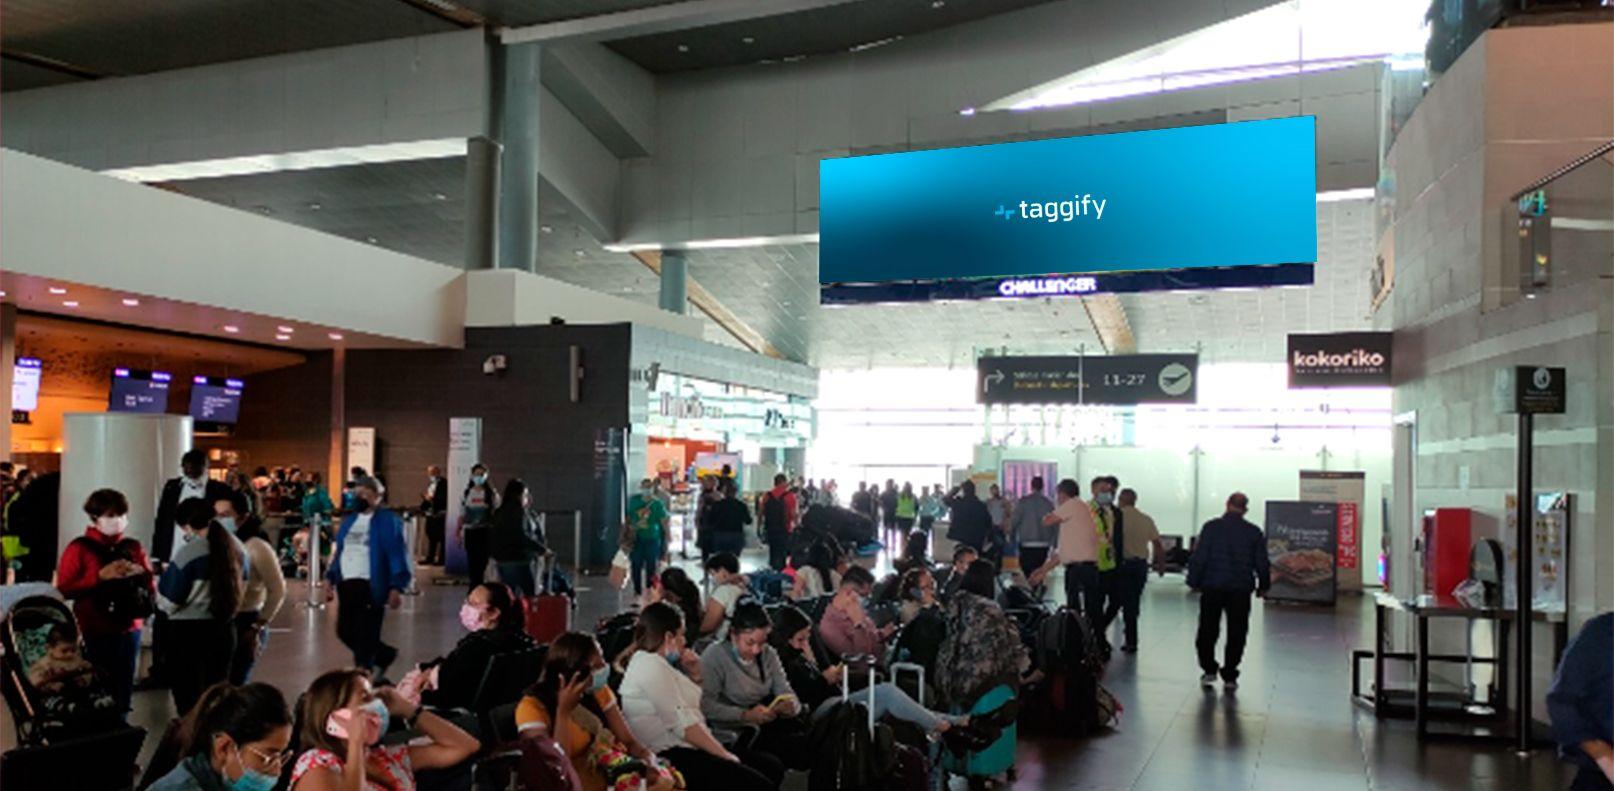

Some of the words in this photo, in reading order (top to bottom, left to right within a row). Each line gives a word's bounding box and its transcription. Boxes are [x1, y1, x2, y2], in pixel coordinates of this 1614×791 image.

[1019, 194, 1106, 222] taggify
[999, 277, 1097, 295] CHALLENGER
[1293, 348, 1385, 367] kokoriko
[1103, 373, 1146, 386] 11-27
